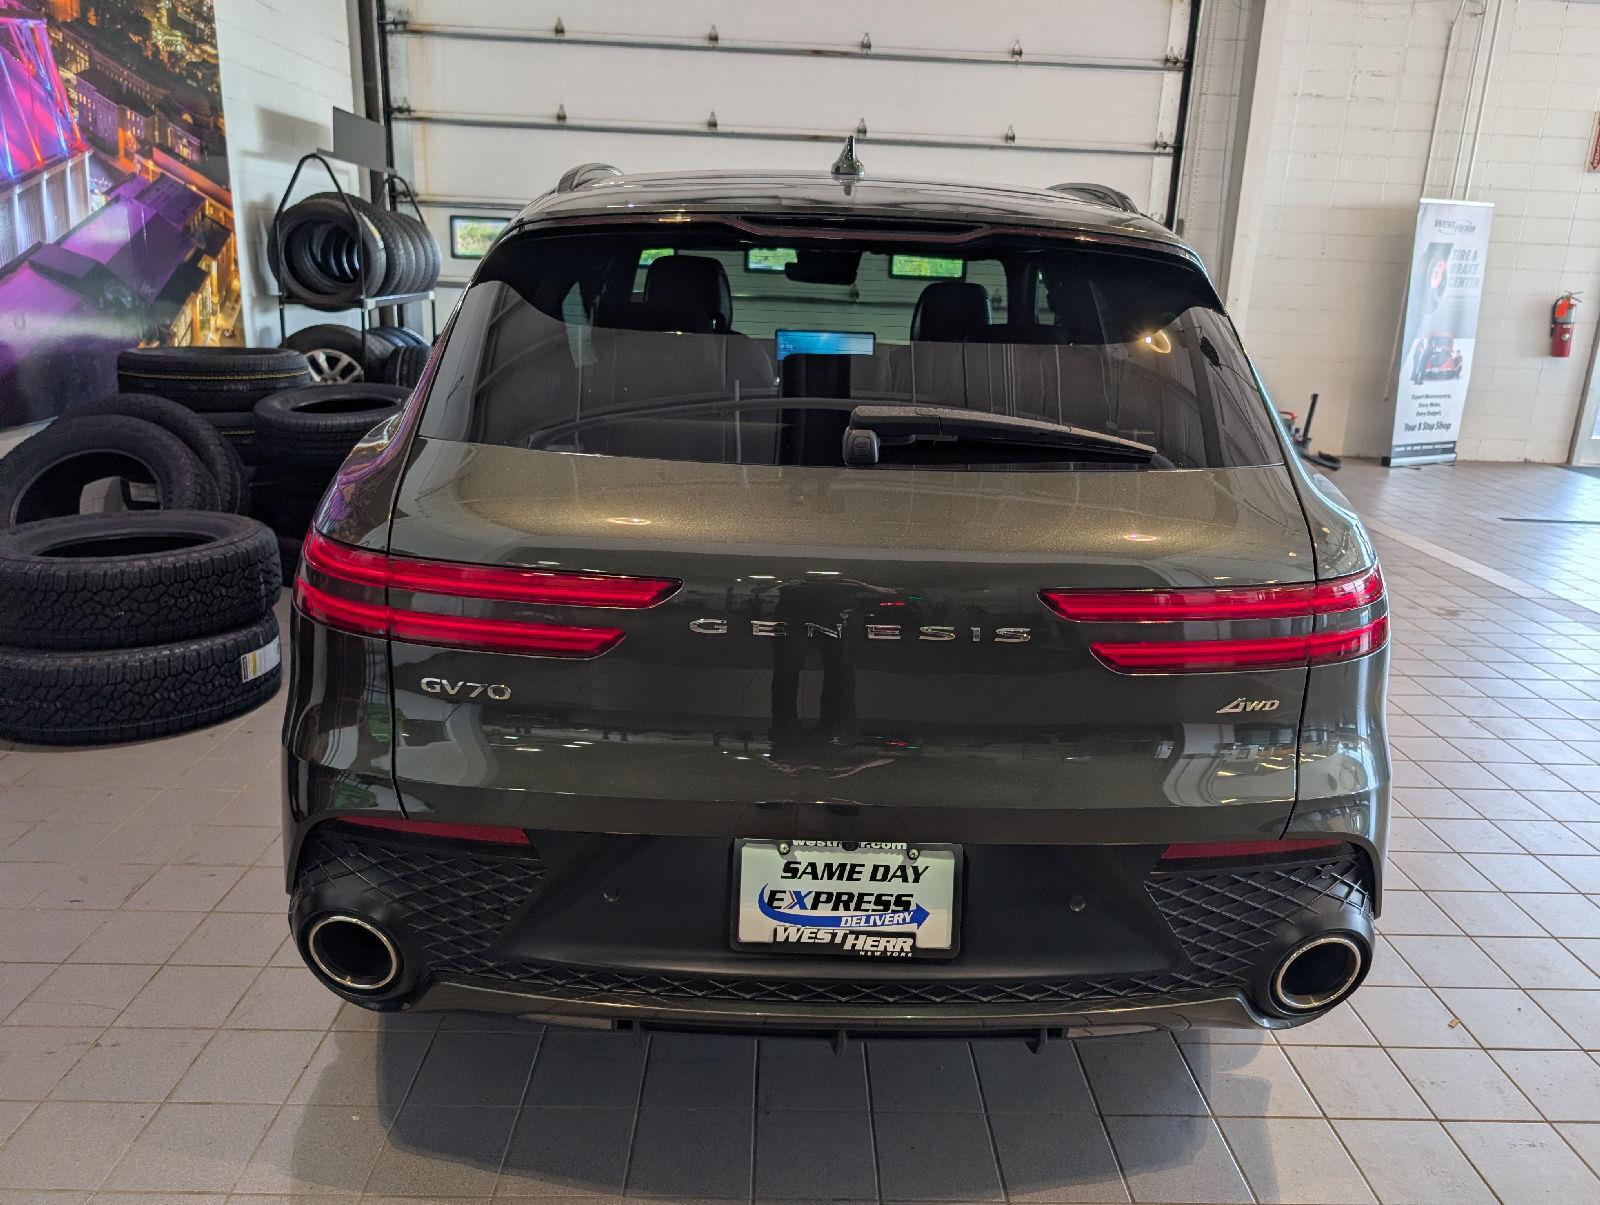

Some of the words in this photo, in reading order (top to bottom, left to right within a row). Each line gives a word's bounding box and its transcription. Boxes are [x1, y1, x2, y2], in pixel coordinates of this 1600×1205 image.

[1435, 420, 1452, 431] Shop
[690, 617, 1034, 643] GENESIS
[421, 677, 511, 700] GV70
[781, 860, 866, 882] SAME
[869, 864, 930, 883] DAY
[766, 889, 914, 913] EXPRESS
[840, 911, 914, 928] DELIVERY
